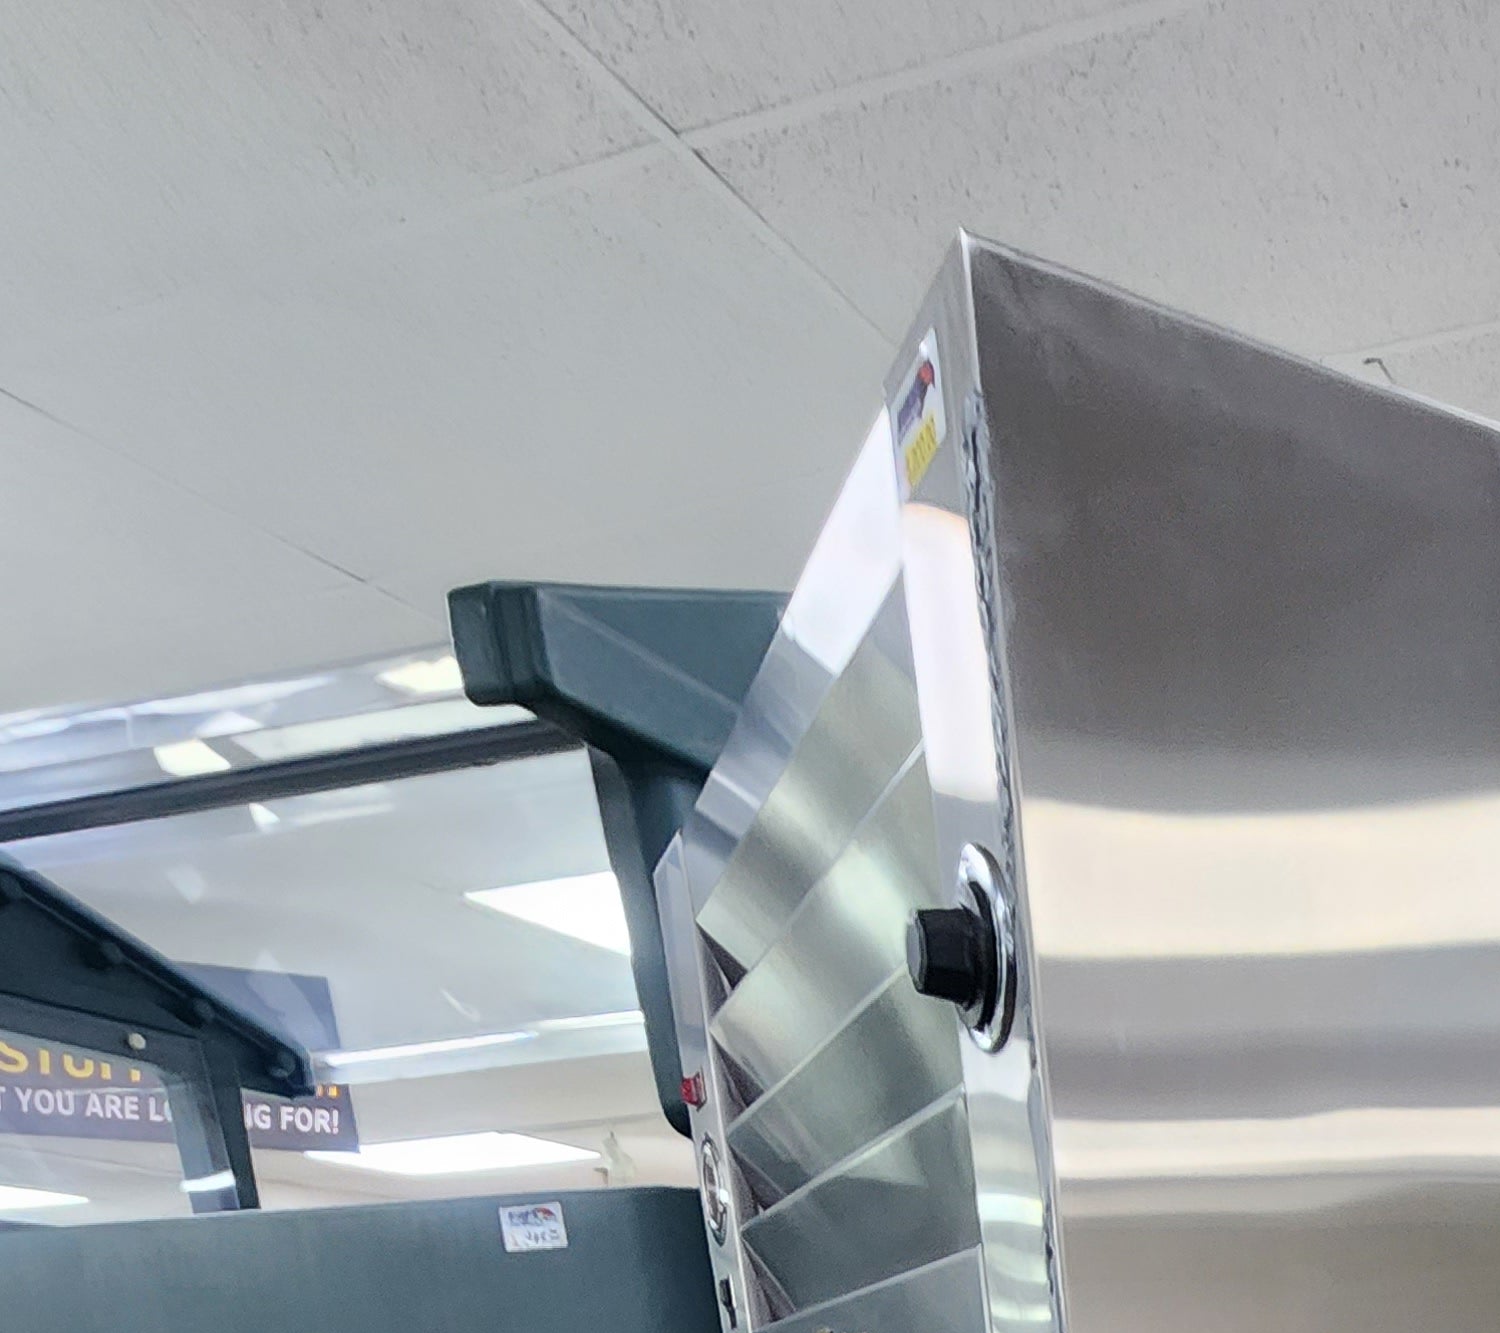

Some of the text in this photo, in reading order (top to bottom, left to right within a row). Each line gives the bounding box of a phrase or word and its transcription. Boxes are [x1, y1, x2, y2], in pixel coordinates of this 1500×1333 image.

[14, 1086, 75, 1116] YOU
[85, 1093, 140, 1121] ARE
[280, 1105, 339, 1134] FOR!
